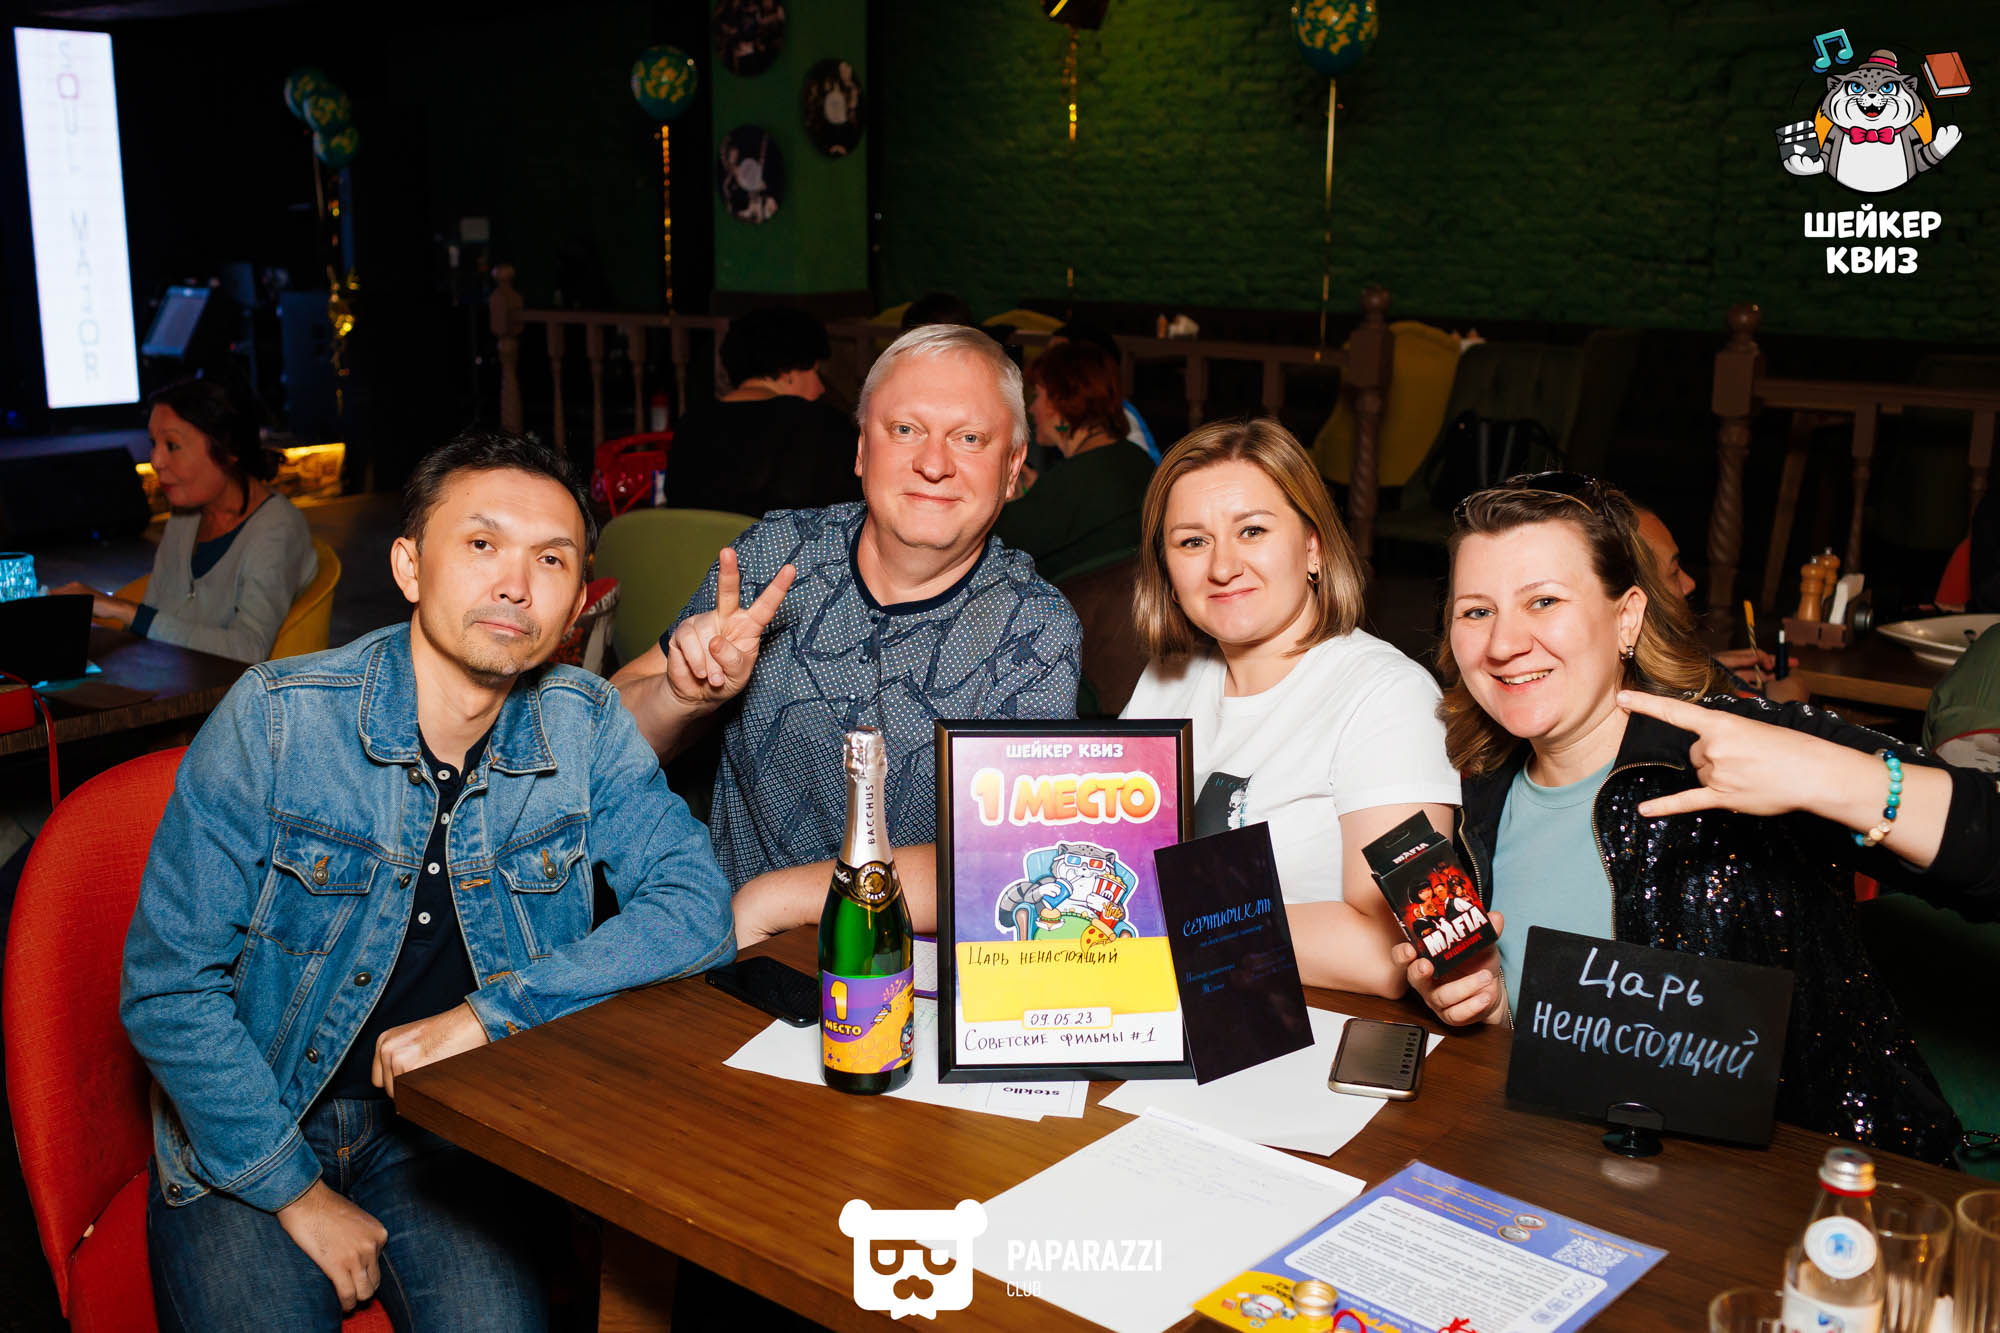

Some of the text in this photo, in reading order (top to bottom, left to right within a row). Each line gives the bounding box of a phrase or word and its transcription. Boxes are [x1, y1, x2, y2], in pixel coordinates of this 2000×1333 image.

[1005, 741, 1124, 759] ШЕЙКЕР КВИЗ
[866, 784, 875, 845] BACCHUS
[973, 769, 1159, 825] 1 МЕСТО
[1422, 905, 1489, 958] MAFIA
[830, 979, 848, 1021] 1
[1578, 947, 1705, 1011] Царь
[825, 1018, 863, 1037] МЕСТО
